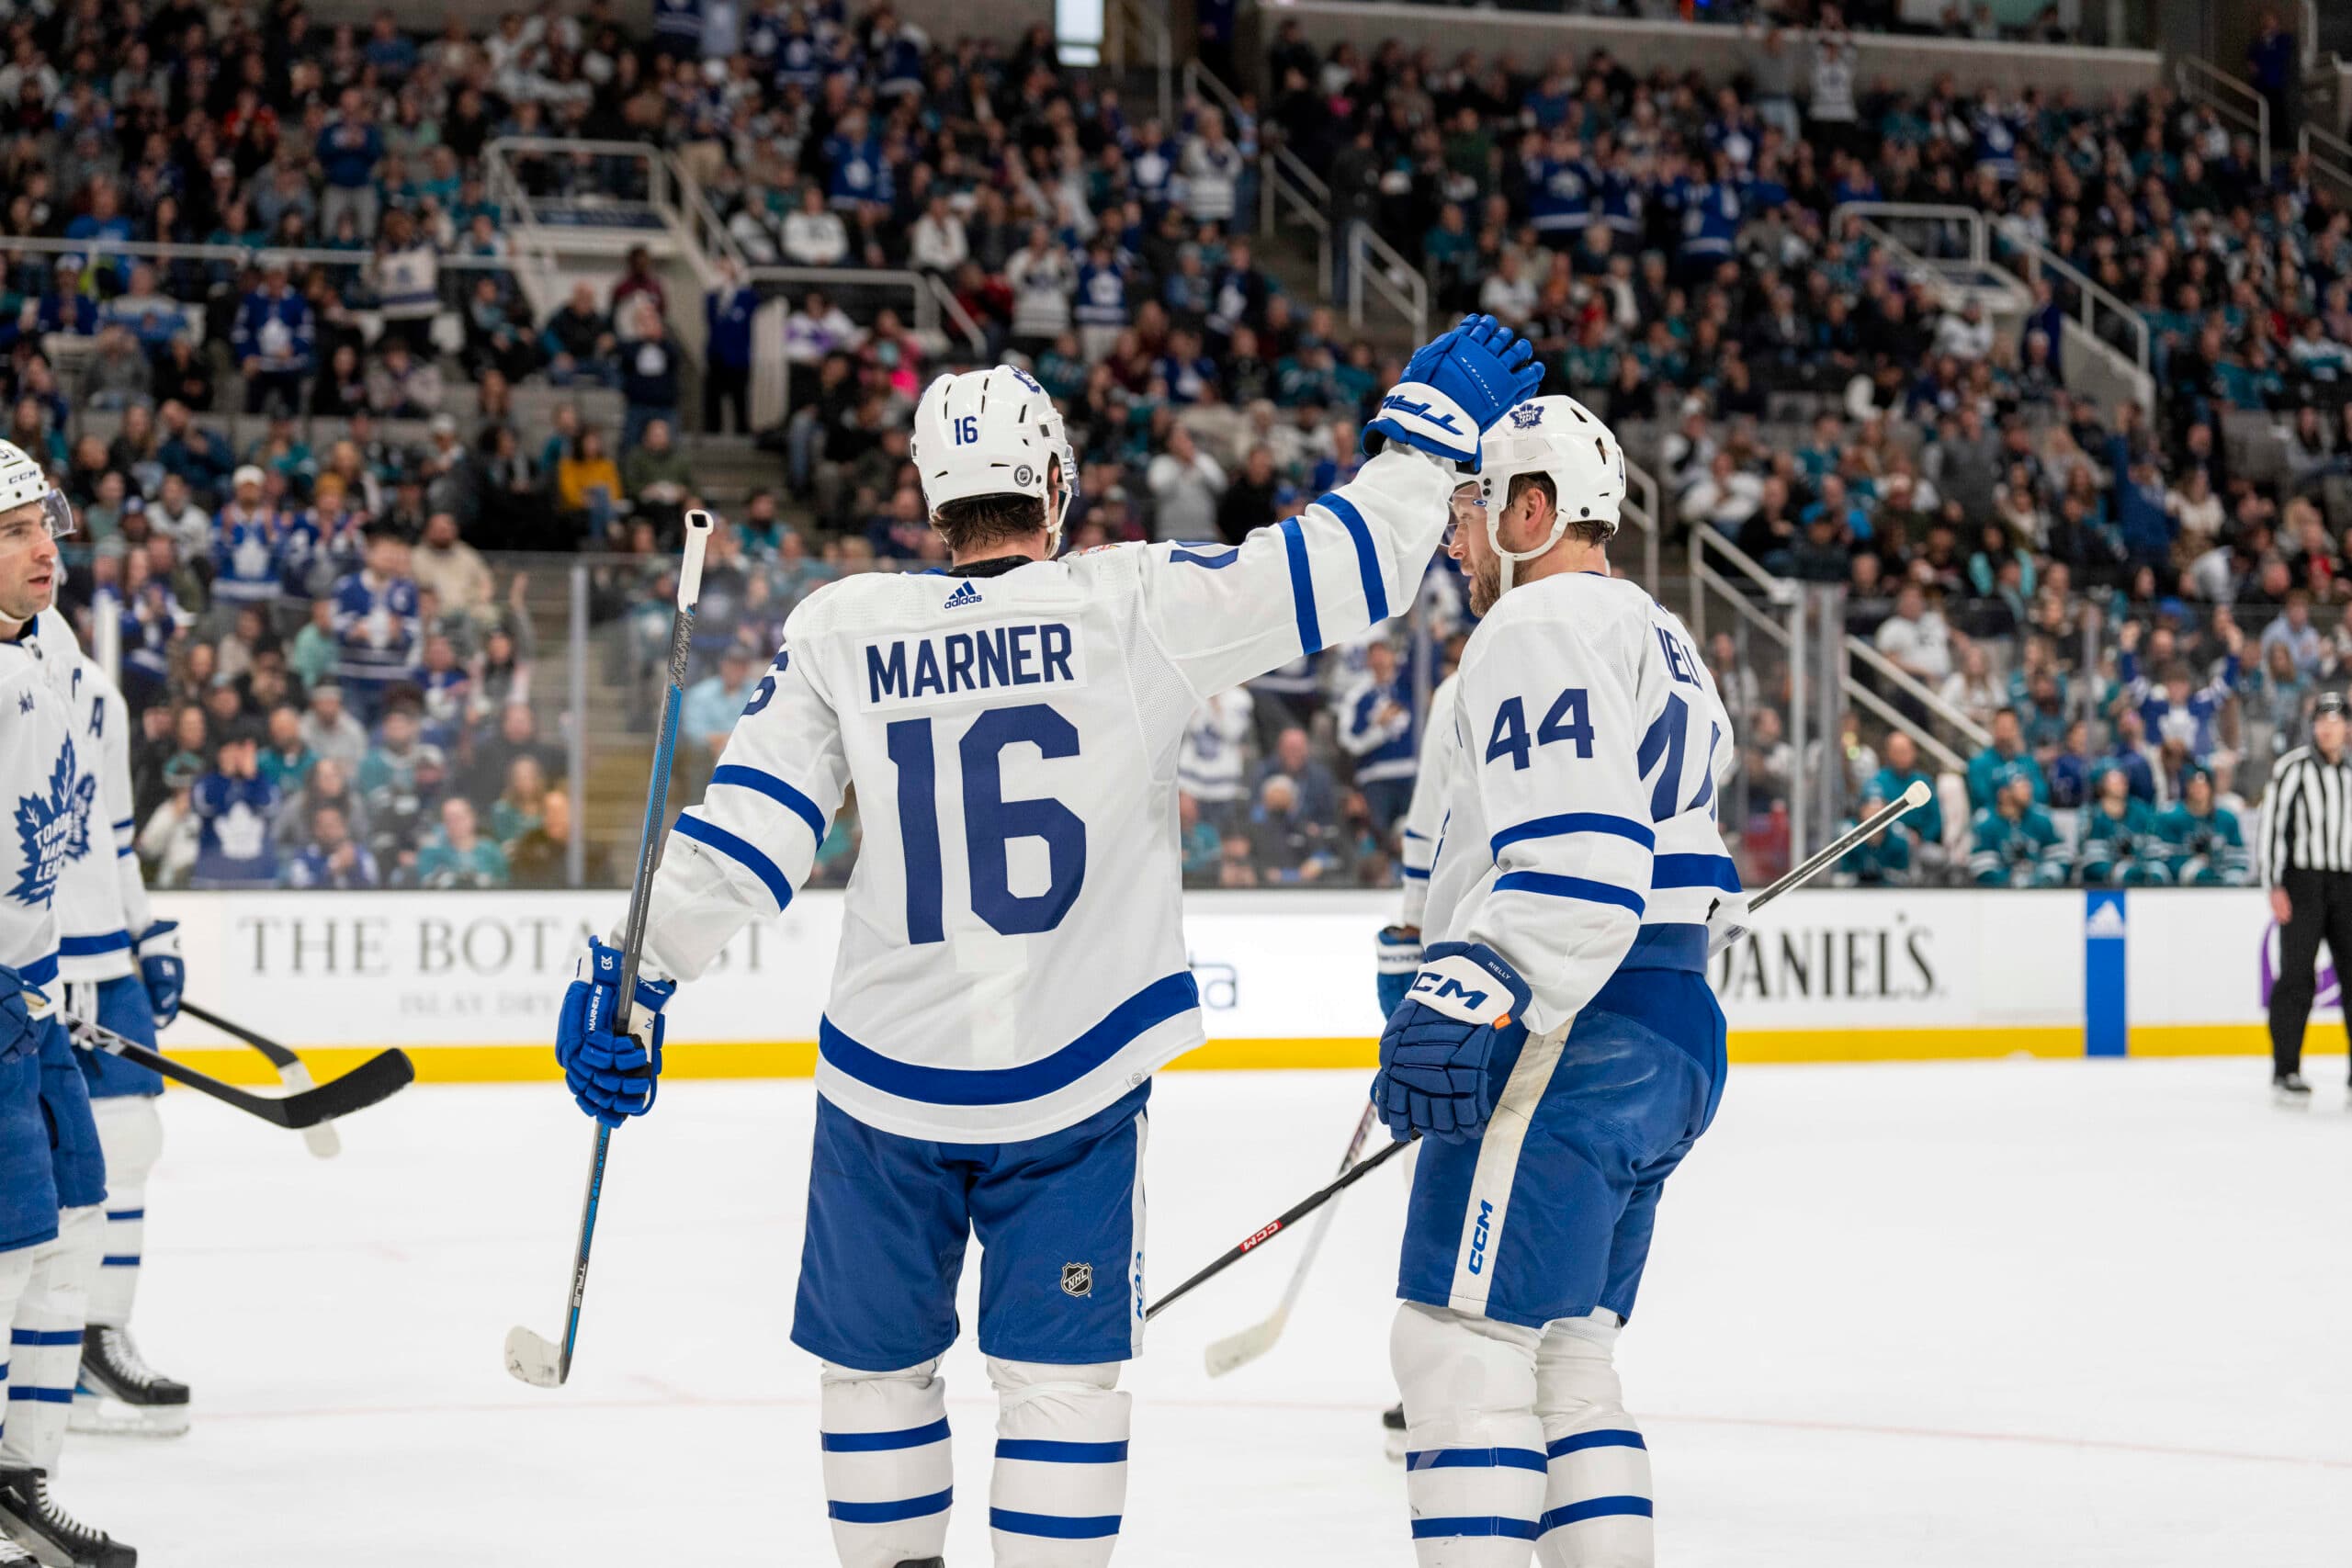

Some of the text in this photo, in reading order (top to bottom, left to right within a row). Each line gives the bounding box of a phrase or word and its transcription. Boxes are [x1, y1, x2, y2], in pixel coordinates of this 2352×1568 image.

[955, 416, 978, 446] 16
[9, 470, 37, 484] CCM
[944, 595, 982, 609] adidas
[865, 623, 1074, 704] MARNER
[88, 697, 103, 738] A
[1486, 688, 1595, 771] 44
[887, 704, 1086, 944] 16
[236, 917, 392, 974] THE
[1487, 961, 1511, 980] RIELLY
[589, 996, 601, 1032] MARNER
[1244, 1222, 1278, 1252] CCM
[1469, 1199, 1493, 1275] CCM
[572, 1264, 586, 1308] TRUE
[1069, 1271, 1087, 1290] NHL
